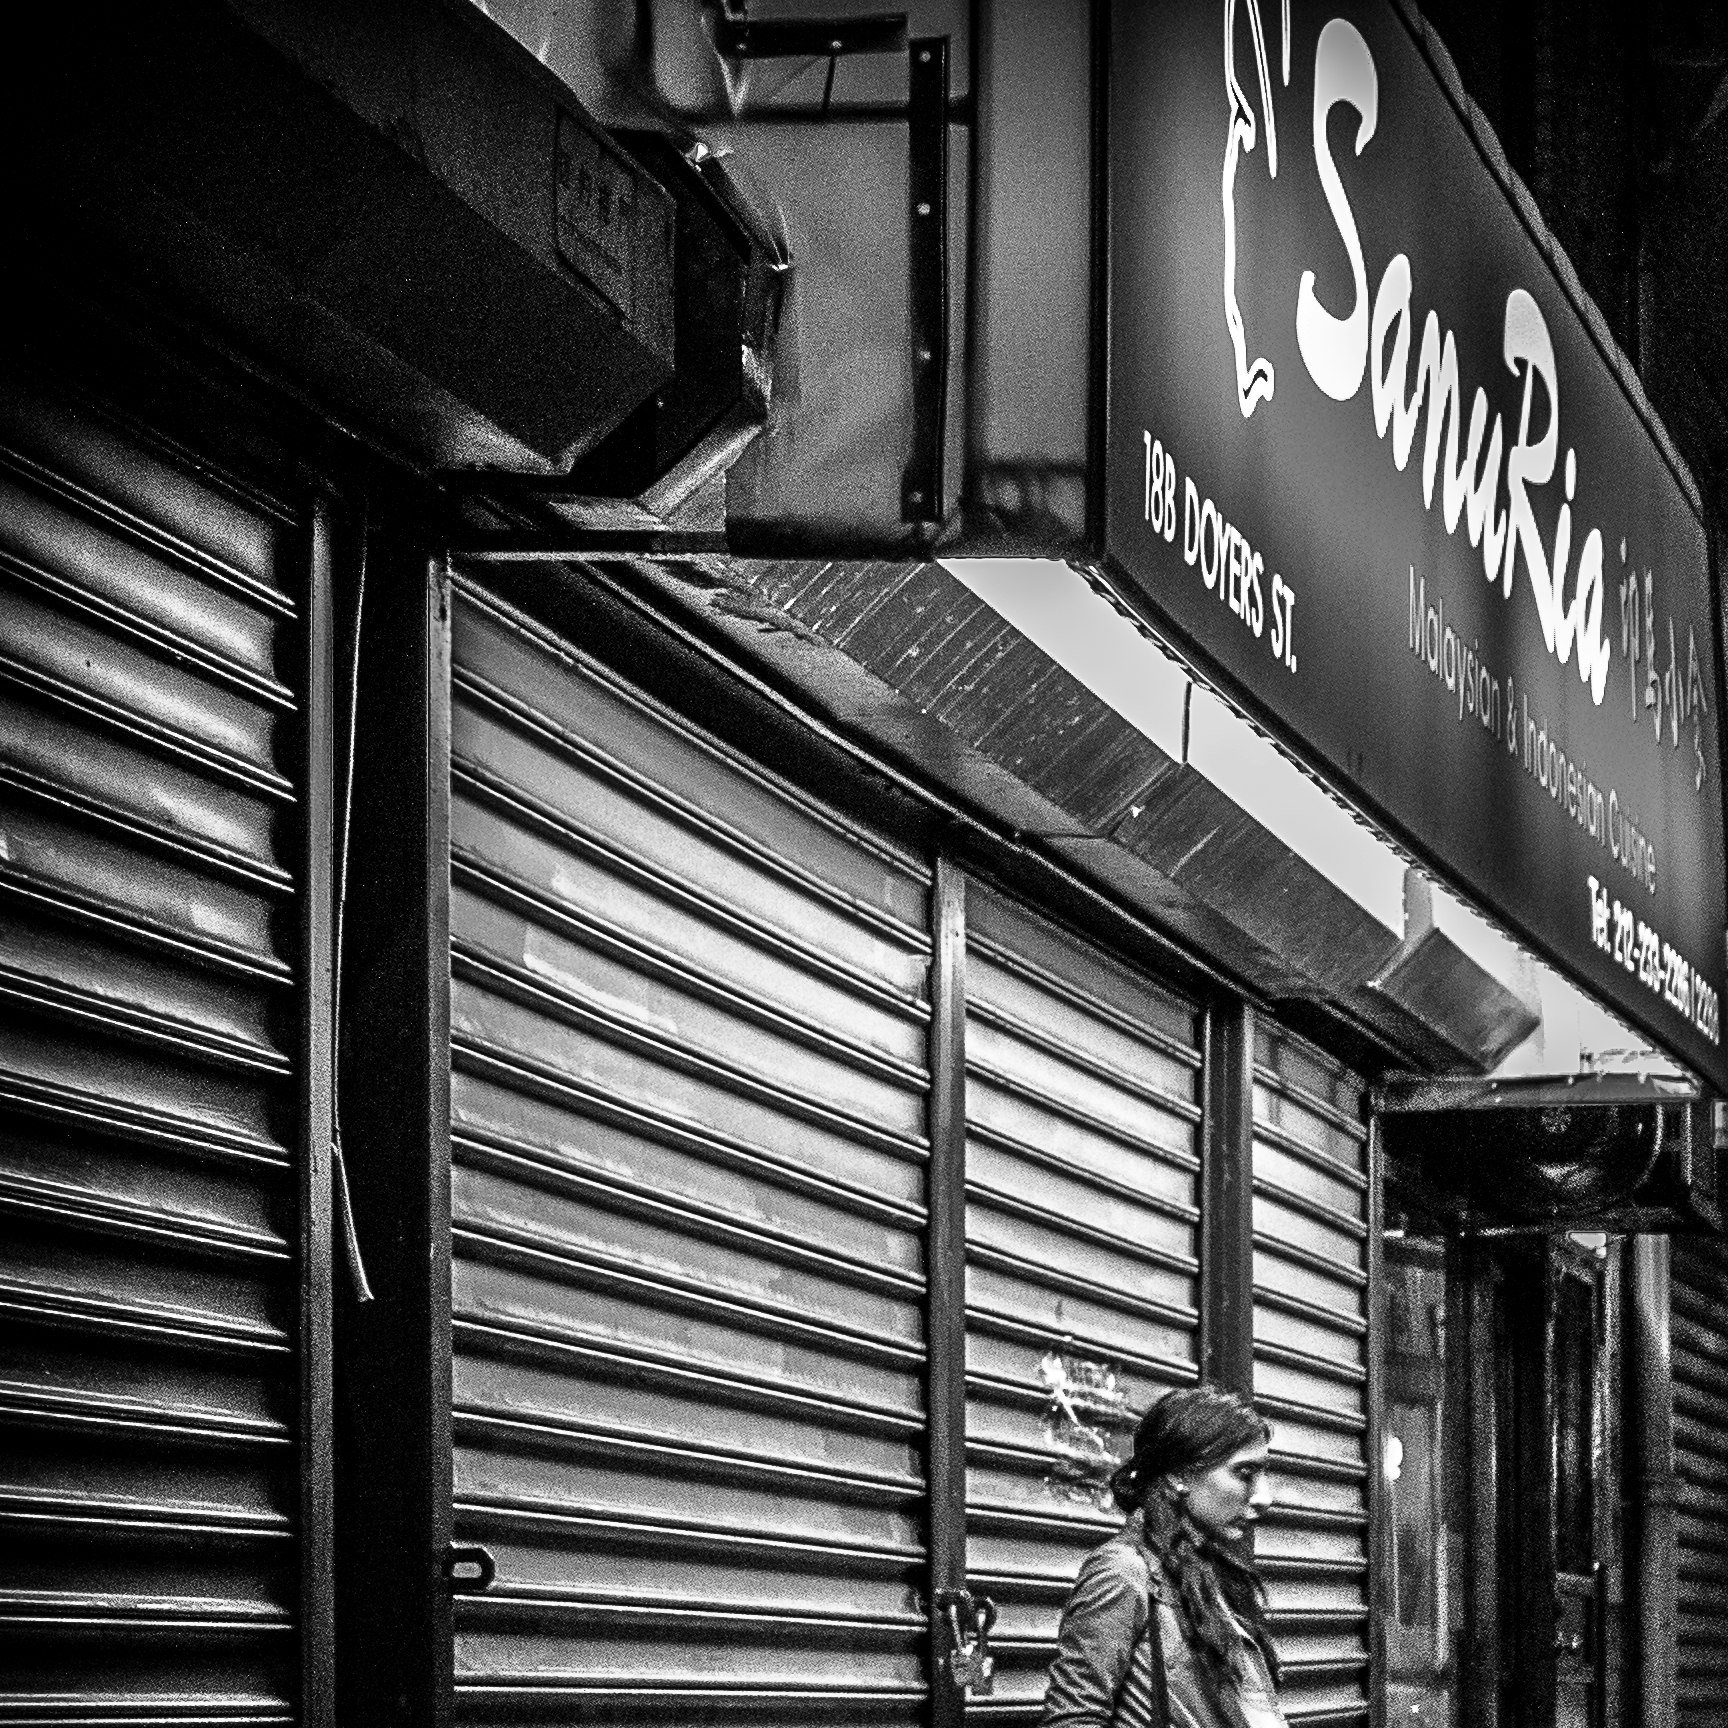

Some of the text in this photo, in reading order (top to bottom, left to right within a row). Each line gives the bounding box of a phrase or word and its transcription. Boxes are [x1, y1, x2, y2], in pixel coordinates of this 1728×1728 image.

[1143, 429, 1297, 674] 18B DOYERS ST.
[1408, 563, 1502, 741] Malaysian
[1505, 675, 1518, 755] &
[1521, 694, 1606, 849] Indonesian
